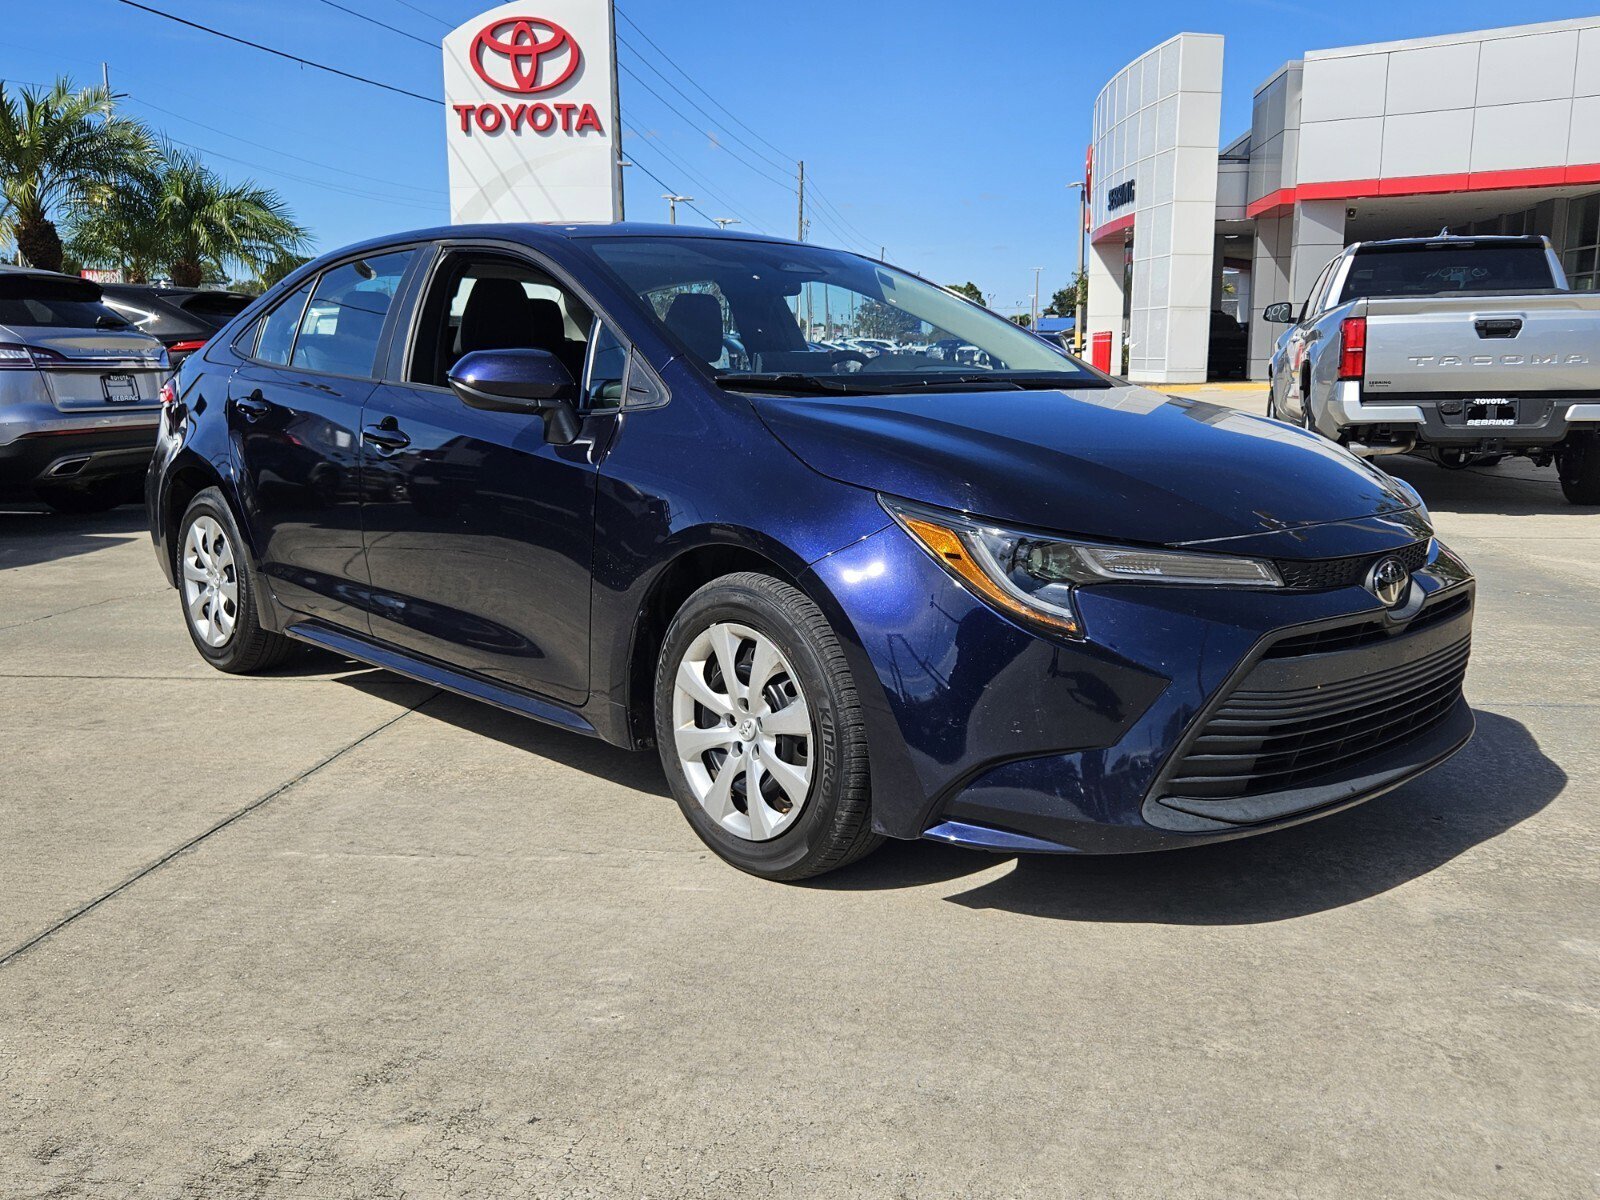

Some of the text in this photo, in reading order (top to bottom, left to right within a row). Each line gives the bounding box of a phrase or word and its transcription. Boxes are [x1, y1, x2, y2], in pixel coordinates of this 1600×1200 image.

[453, 102, 603, 132] TOYOTA
[1407, 354, 1590, 367] TACOMA
[1466, 419, 1515, 427] SEBRING
